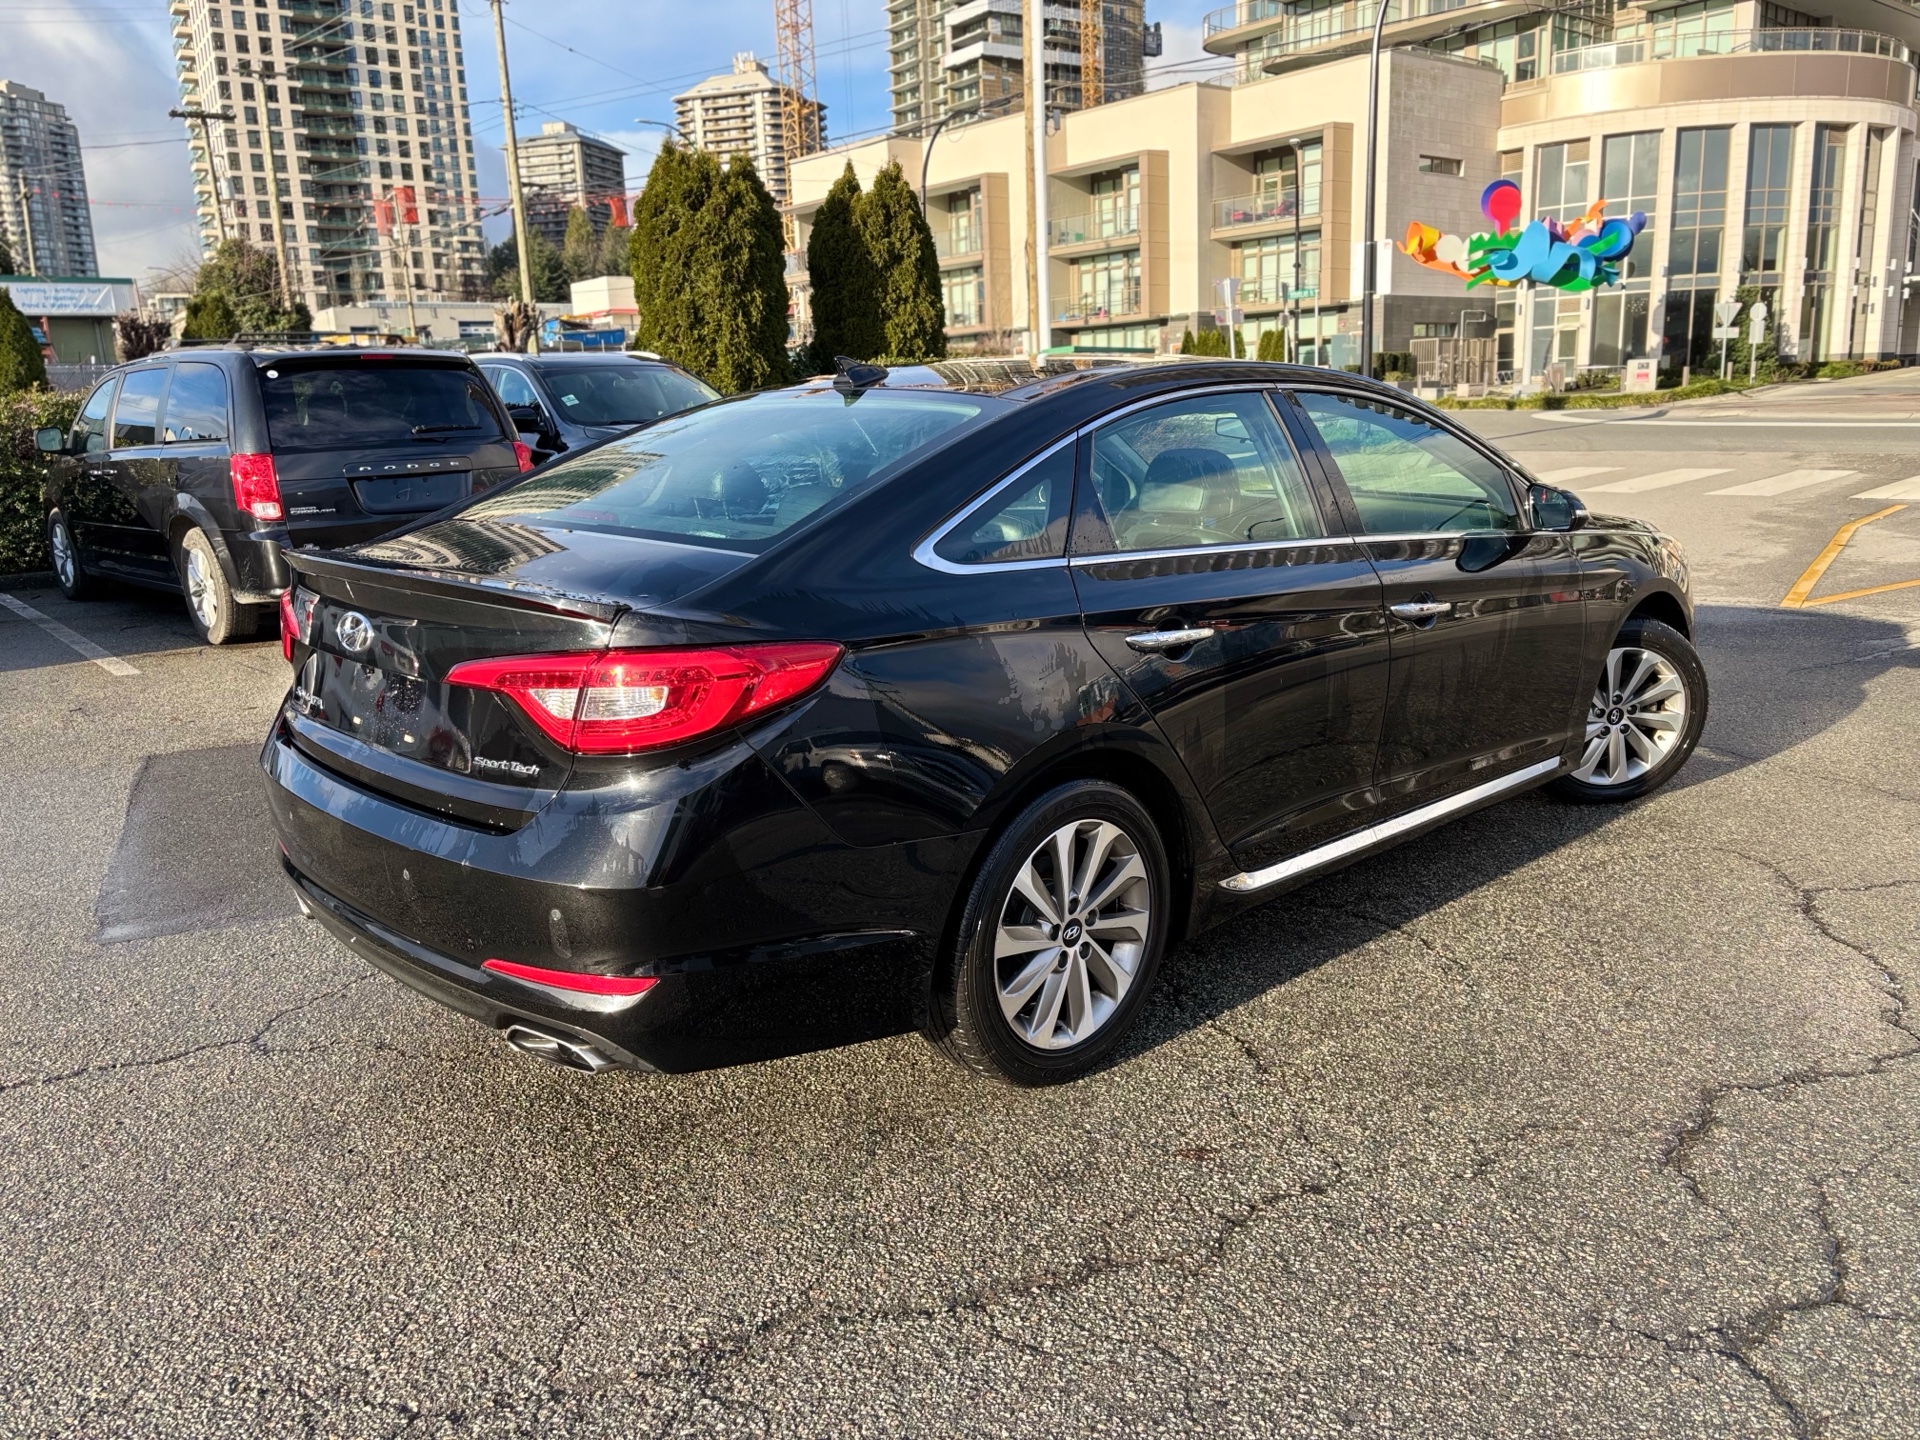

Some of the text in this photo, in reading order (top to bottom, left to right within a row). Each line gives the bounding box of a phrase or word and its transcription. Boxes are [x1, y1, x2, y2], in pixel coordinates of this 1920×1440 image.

[16, 287, 47, 295] Lighting
[359, 461, 460, 472] DODGE
[473, 756, 540, 775] Sport Tech
